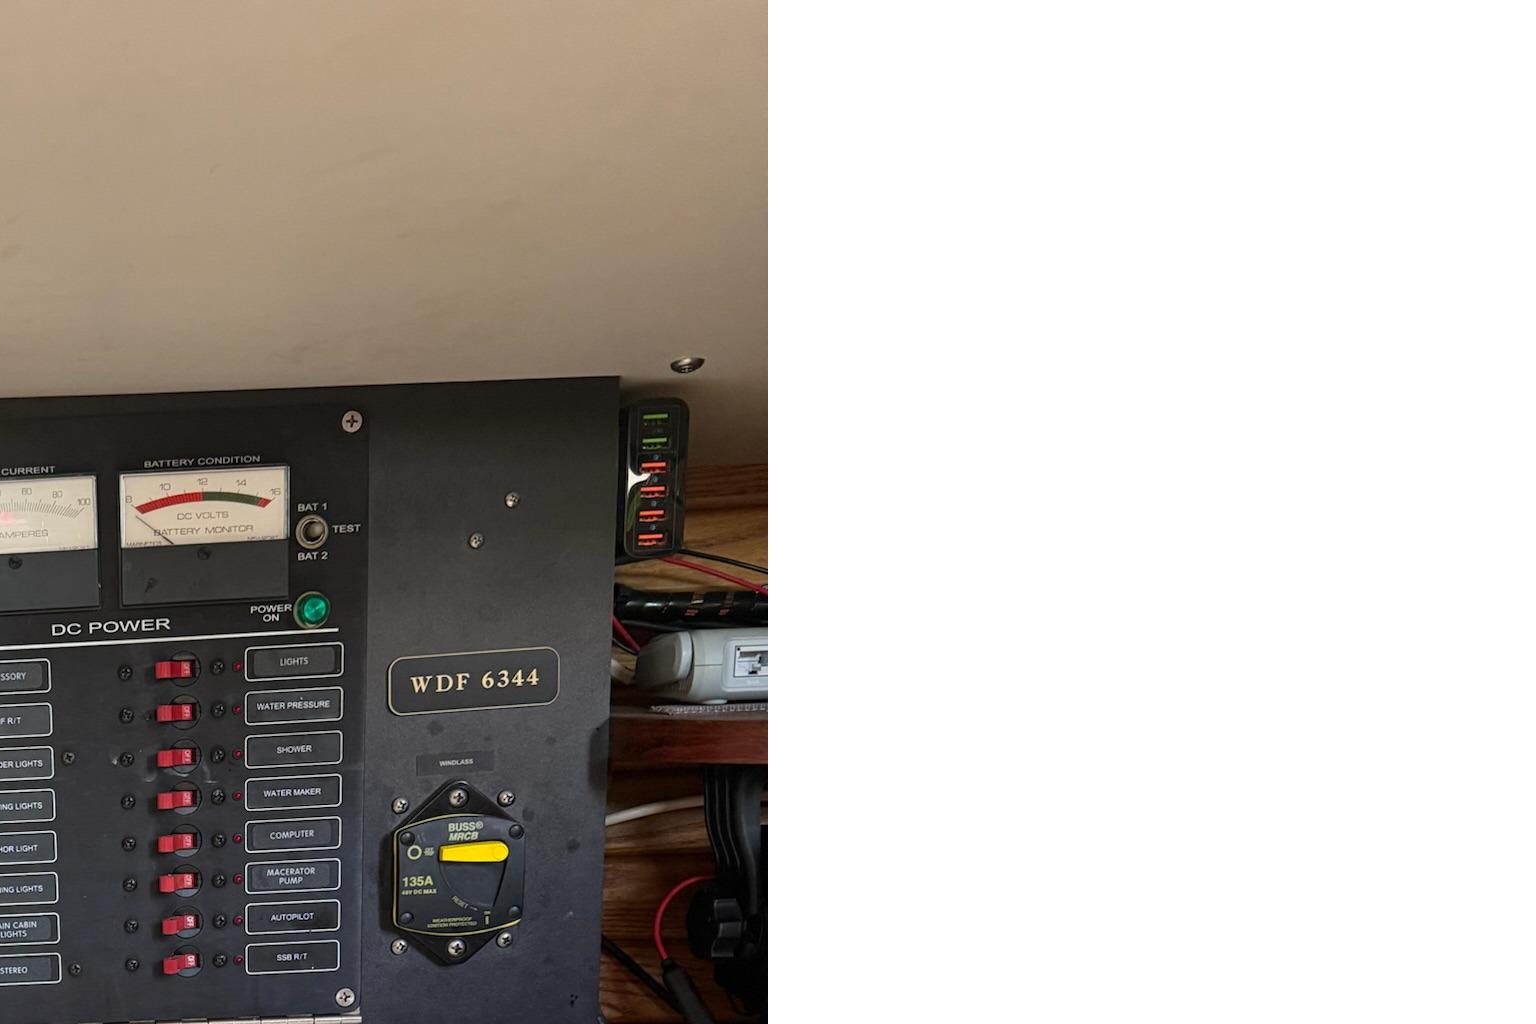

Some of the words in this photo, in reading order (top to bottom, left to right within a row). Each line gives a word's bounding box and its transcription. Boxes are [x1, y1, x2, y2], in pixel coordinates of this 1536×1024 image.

[144, 458, 195, 469] BATTERY
[197, 455, 261, 466] CONDITION
[1, 465, 56, 476] CURRENT
[159, 483, 171, 491] 10
[197, 478, 209, 486] 12
[235, 479, 247, 487] 14
[52, 490, 63, 499] 80
[270, 488, 281, 496] 16
[77, 497, 91, 506] 100
[297, 503, 319, 512] BAT
[322, 502, 328, 511] 1
[176, 511, 192, 521] DC
[195, 511, 230, 520] VOLTS
[153, 527, 201, 537] BATTERY
[204, 524, 254, 535] MONITOR
[332, 523, 361, 533] TEST
[297, 552, 318, 561] BAT
[321, 551, 329, 560] 2
[250, 603, 292, 614] POWER
[262, 614, 280, 622] ON
[51, 623, 82, 637] DC
[88, 617, 172, 635] POWER
[279, 656, 309, 667] LIGHTS
[410, 672, 470, 694] WDF
[480, 668, 540, 689] 6344
[256, 702, 285, 711] WATER
[286, 700, 330, 710] PRESSURE
[7, 716, 22, 725] R/T
[276, 744, 312, 755] SHOWER
[15, 759, 44, 769] LIGHTS
[439, 758, 474, 767] WINDLASS
[263, 788, 291, 798] WATER
[293, 787, 321, 797] MAKER
[14, 801, 43, 811] LIGHTS
[270, 830, 314, 840] COMPUTER
[448, 831, 479, 841] MRCB
[15, 844, 38, 853] LIGHT
[266, 866, 315, 877] MACERATOR
[279, 876, 303, 885] PUMP
[402, 875, 434, 887] 135A
[15, 884, 43, 894] LIGHTS
[270, 912, 314, 922] AUTOPILOT
[12, 920, 37, 929] CABIN
[0, 929, 27, 939] LIGHTS
[276, 953, 293, 962] SSB
[294, 952, 307, 961] R/T
[0, 965, 28, 975] STEREO
